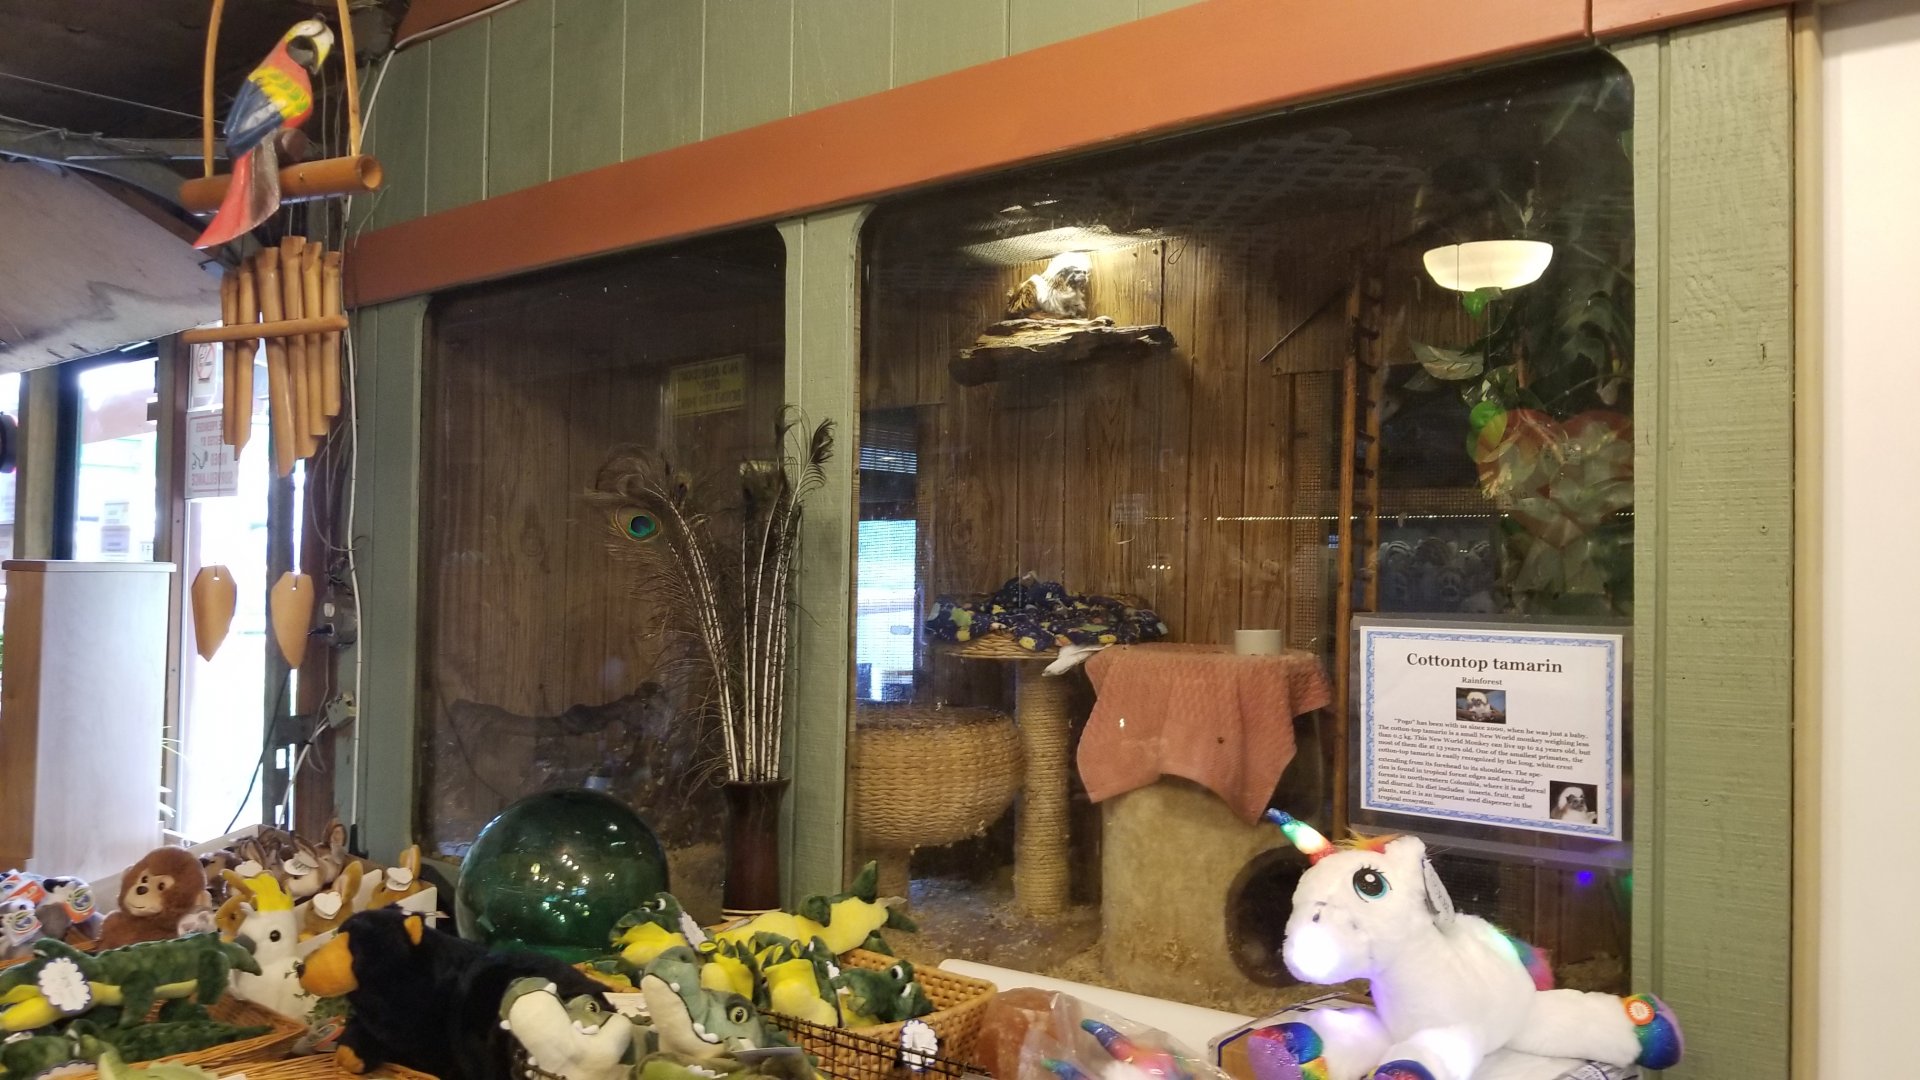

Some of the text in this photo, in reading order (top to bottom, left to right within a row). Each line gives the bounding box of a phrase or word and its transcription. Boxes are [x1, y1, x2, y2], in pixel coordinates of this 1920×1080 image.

[1406, 652, 1562, 673] Cottontop tamarin
[1461, 676, 1502, 685] Rainforest
[1390, 726, 1422, 734] cotton-top
[1494, 733, 1515, 741] World
[1516, 736, 1543, 744] monkey
[1544, 738, 1575, 747] weighing
[1464, 738, 1489, 747] Monkey
[1378, 747, 1409, 756] cotton-top
[1442, 753, 1460, 761] easily
[1461, 755, 1496, 763] recognized
[1497, 757, 1505, 765] by
[1509, 751, 1537, 759] smallest
[1378, 757, 1408, 765] extending
[1408, 758, 1424, 766] from
[1433, 761, 1462, 769] forehead
[1378, 770, 1399, 778] forests
[1407, 775, 1448, 784] northwestern
[1517, 786, 1546, 794] arboreal
[1397, 765, 1415, 773] found
[1423, 768, 1448, 776] tropical
[1448, 770, 1467, 778] forest
[1467, 772, 1487, 780] edges
[1500, 777, 1535, 786] secondary
[1437, 785, 1465, 793] includes
[1433, 792, 1465, 801] important
[1481, 797, 1512, 806] disperser
